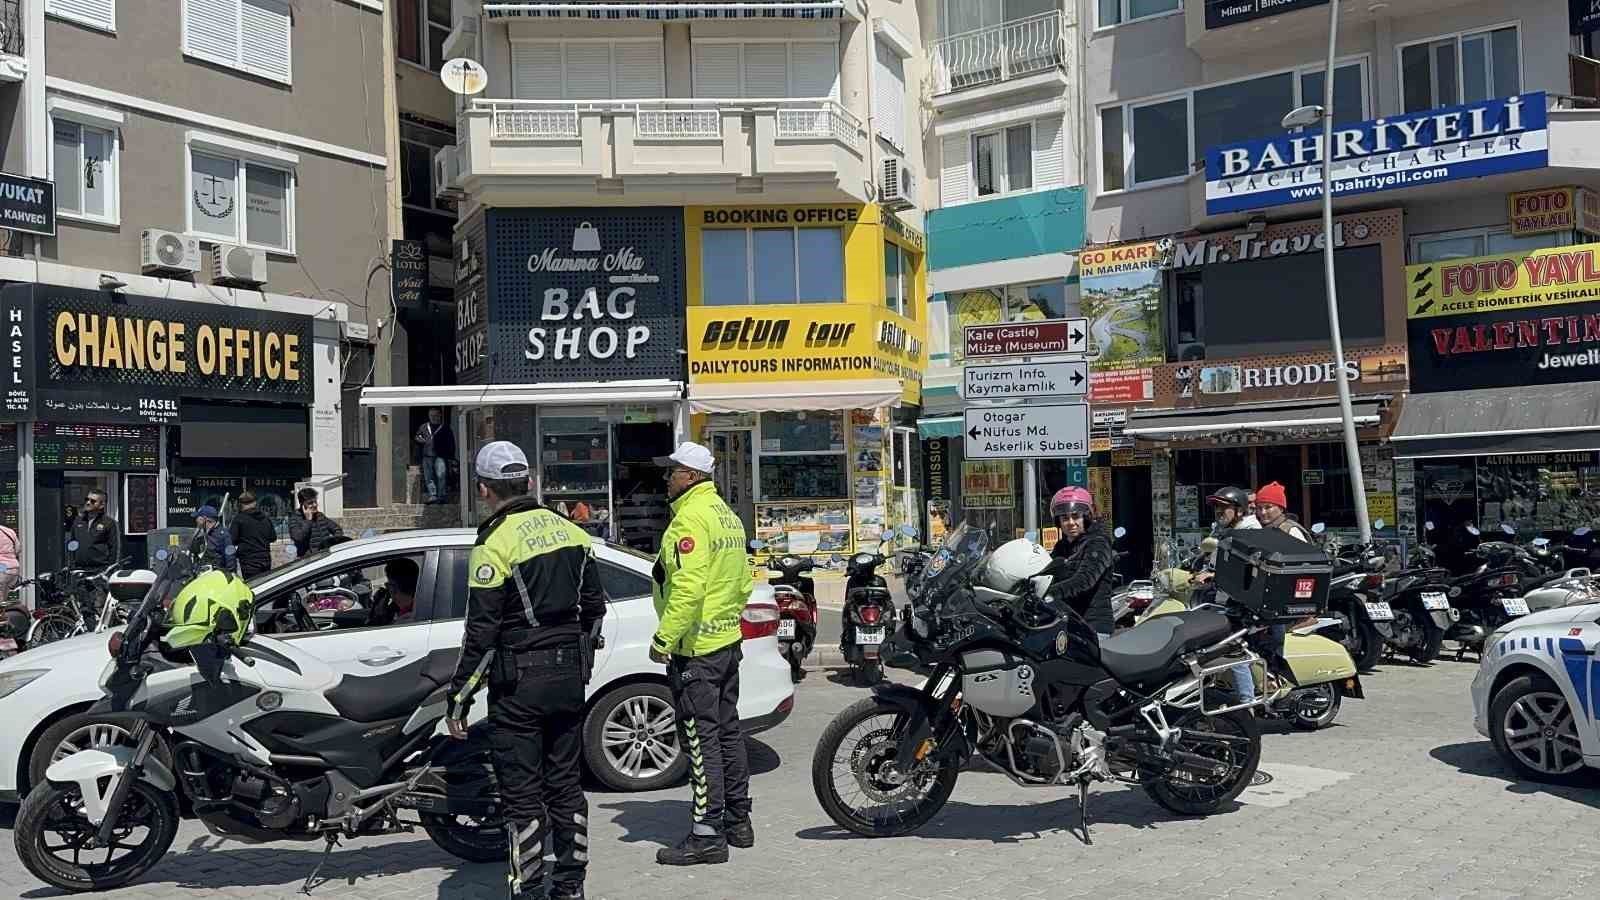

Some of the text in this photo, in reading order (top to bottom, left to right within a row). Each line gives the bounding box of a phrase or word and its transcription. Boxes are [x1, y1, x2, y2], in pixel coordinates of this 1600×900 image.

[1221, 3, 1253, 18] Mimar
[1221, 96, 1526, 176] BAHRİYELİ
[1358, 137, 1521, 173] CHARTER
[704, 207, 857, 224] BOOKING OFFICE
[1174, 223, 1347, 269] Mr. Travel
[527, 246, 645, 272] Mamma Mia
[1081, 252, 1106, 265] GO
[1440, 258, 1518, 298] FOTO
[457, 290, 477, 331] BAG
[540, 286, 636, 321] BAG
[1441, 301, 1474, 312] ACELE
[1478, 292, 1542, 307] BİOMETRİK
[525, 325, 651, 360] SHOP
[967, 327, 1039, 341] Kale (Castle)
[55, 311, 300, 381] CHANGE OFFICE
[455, 331, 484, 373] SHOP
[967, 339, 1065, 354] Müze (Museum)
[782, 356, 872, 373] INFORMATION
[1538, 348, 1600, 369] Jewell
[968, 368, 1047, 381] Turizm Info.
[1243, 360, 1360, 388] RHODES
[968, 381, 1056, 396] Kaymakamlık
[139, 399, 177, 410] HASEL
[983, 412, 1026, 424] Otogar
[983, 425, 1049, 437] Nüfus Md.
[984, 441, 1034, 452] Askerlik
[1039, 439, 1084, 452] Şubesi
[1486, 455, 1513, 464] ALTIN
[1297, 581, 1313, 591] 112
